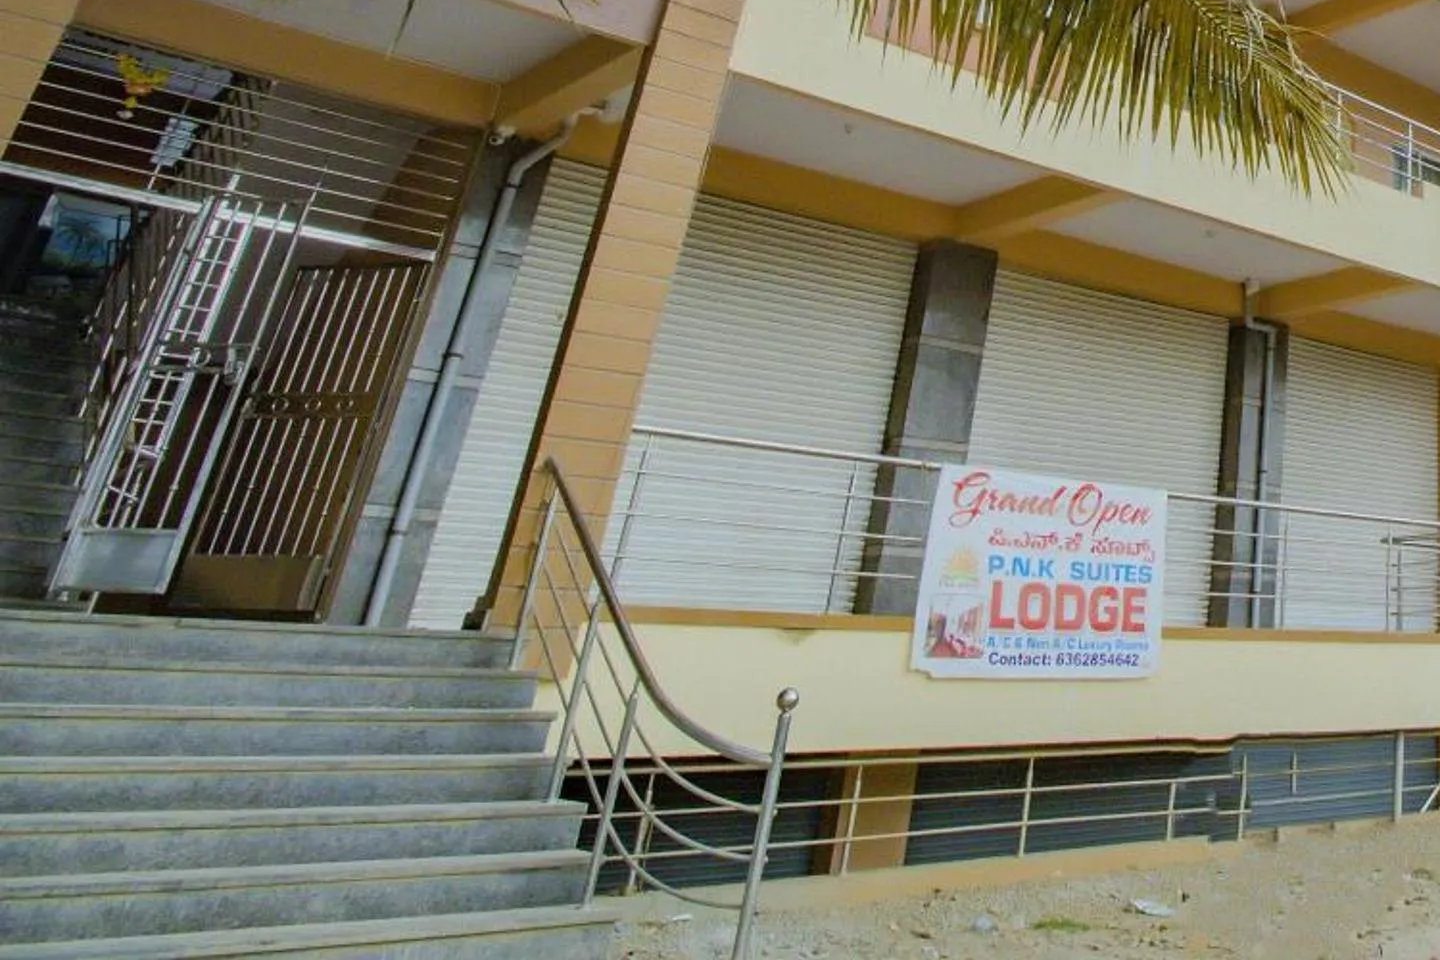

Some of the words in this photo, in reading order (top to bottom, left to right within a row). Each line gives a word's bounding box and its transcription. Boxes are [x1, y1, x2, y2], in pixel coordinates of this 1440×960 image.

[948, 471, 1067, 528] Grand
[1067, 483, 1153, 536] Open
[988, 555, 1054, 579] P.N.K
[1069, 561, 1153, 583] SUITES
[989, 580, 1146, 633] LODGE
[988, 651, 1051, 667] Contact:
[1055, 652, 1140, 668] 6362854642
